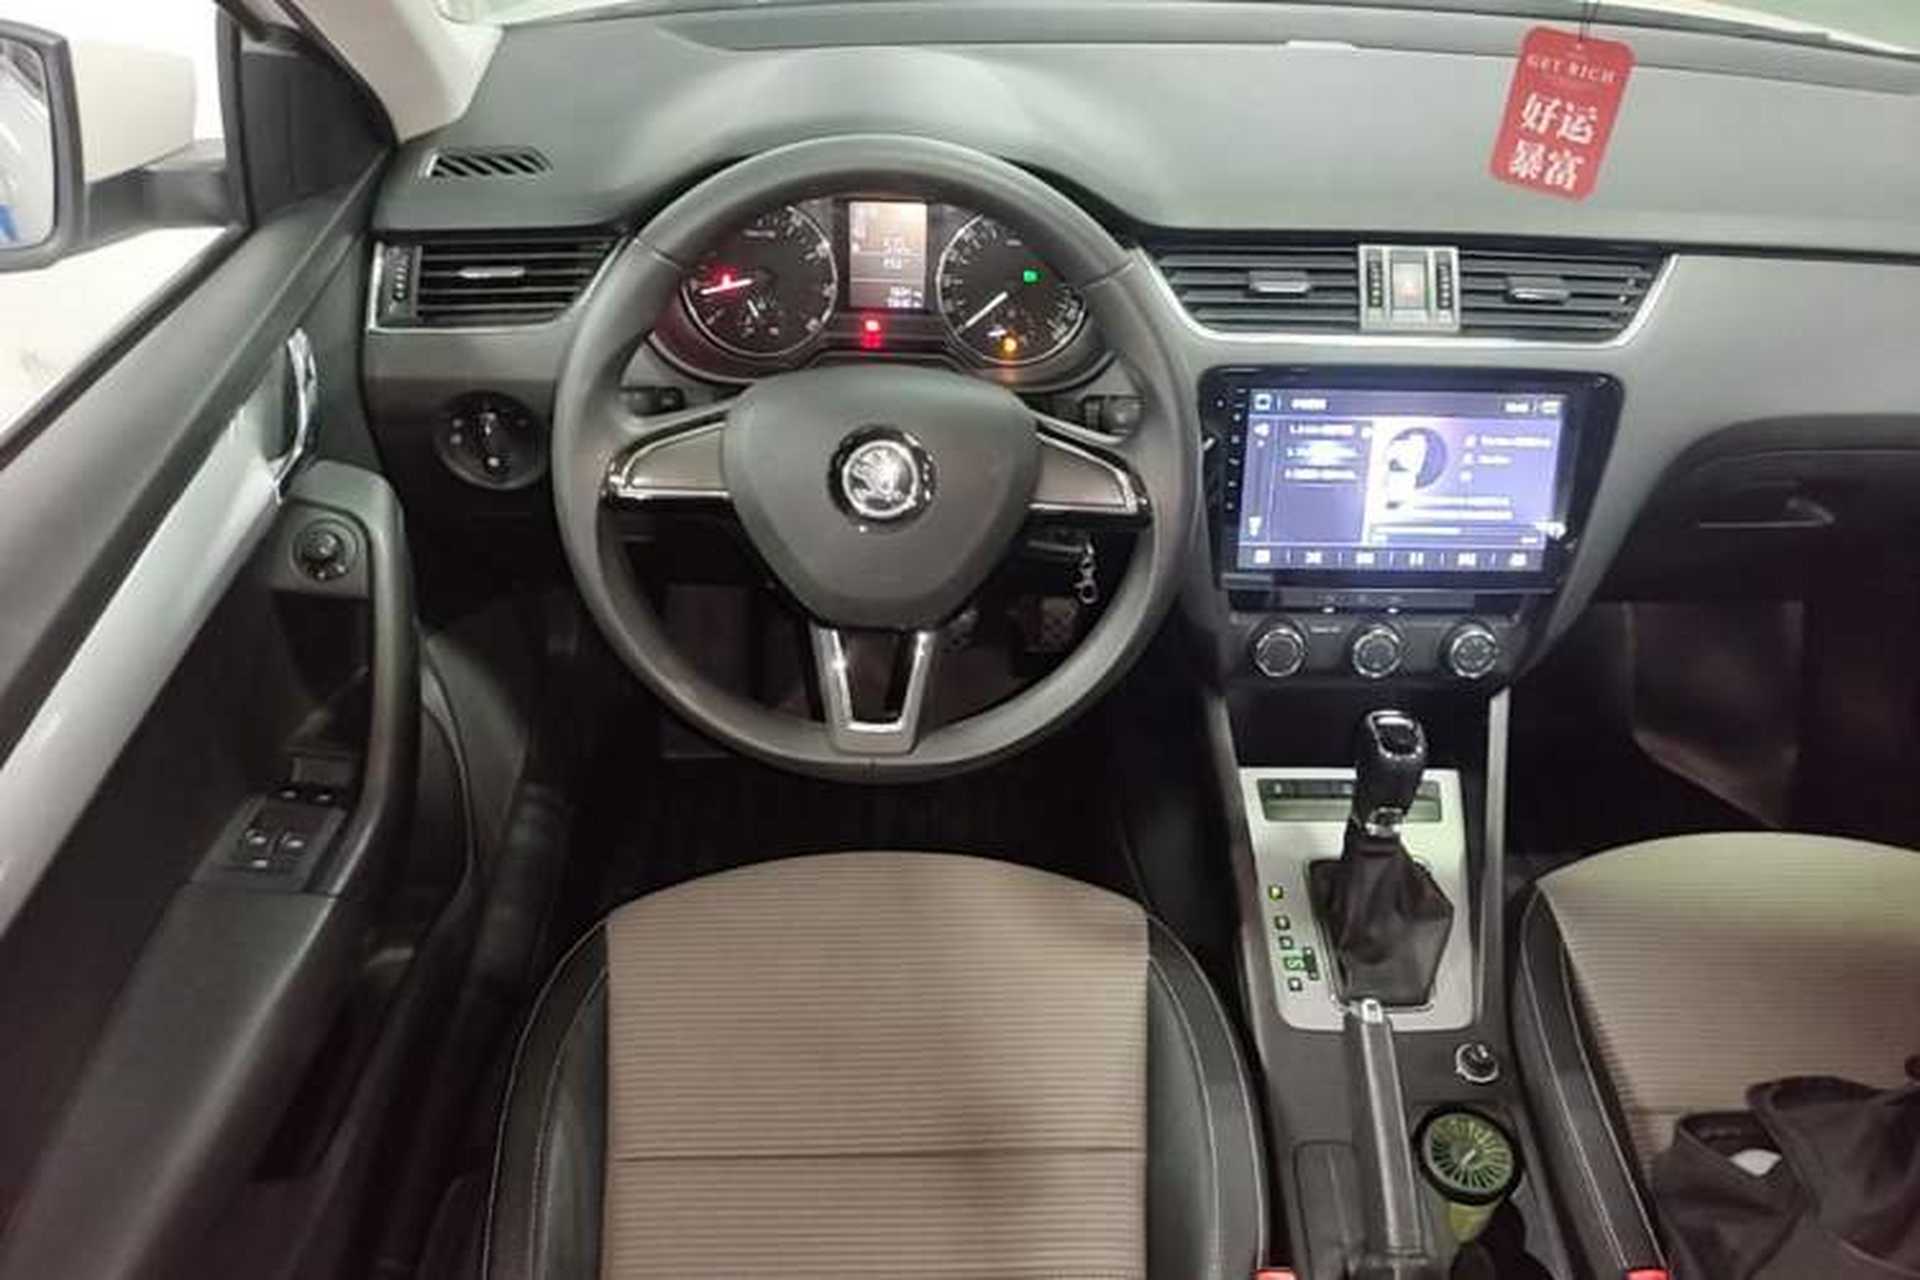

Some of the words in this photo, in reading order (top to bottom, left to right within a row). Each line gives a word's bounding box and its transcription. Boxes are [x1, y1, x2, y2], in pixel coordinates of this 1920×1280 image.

[1525, 53, 1561, 72] GET
[1568, 61, 1617, 83] RICH
[1520, 92, 1598, 145] 好运
[1509, 138, 1585, 191] 暴富
